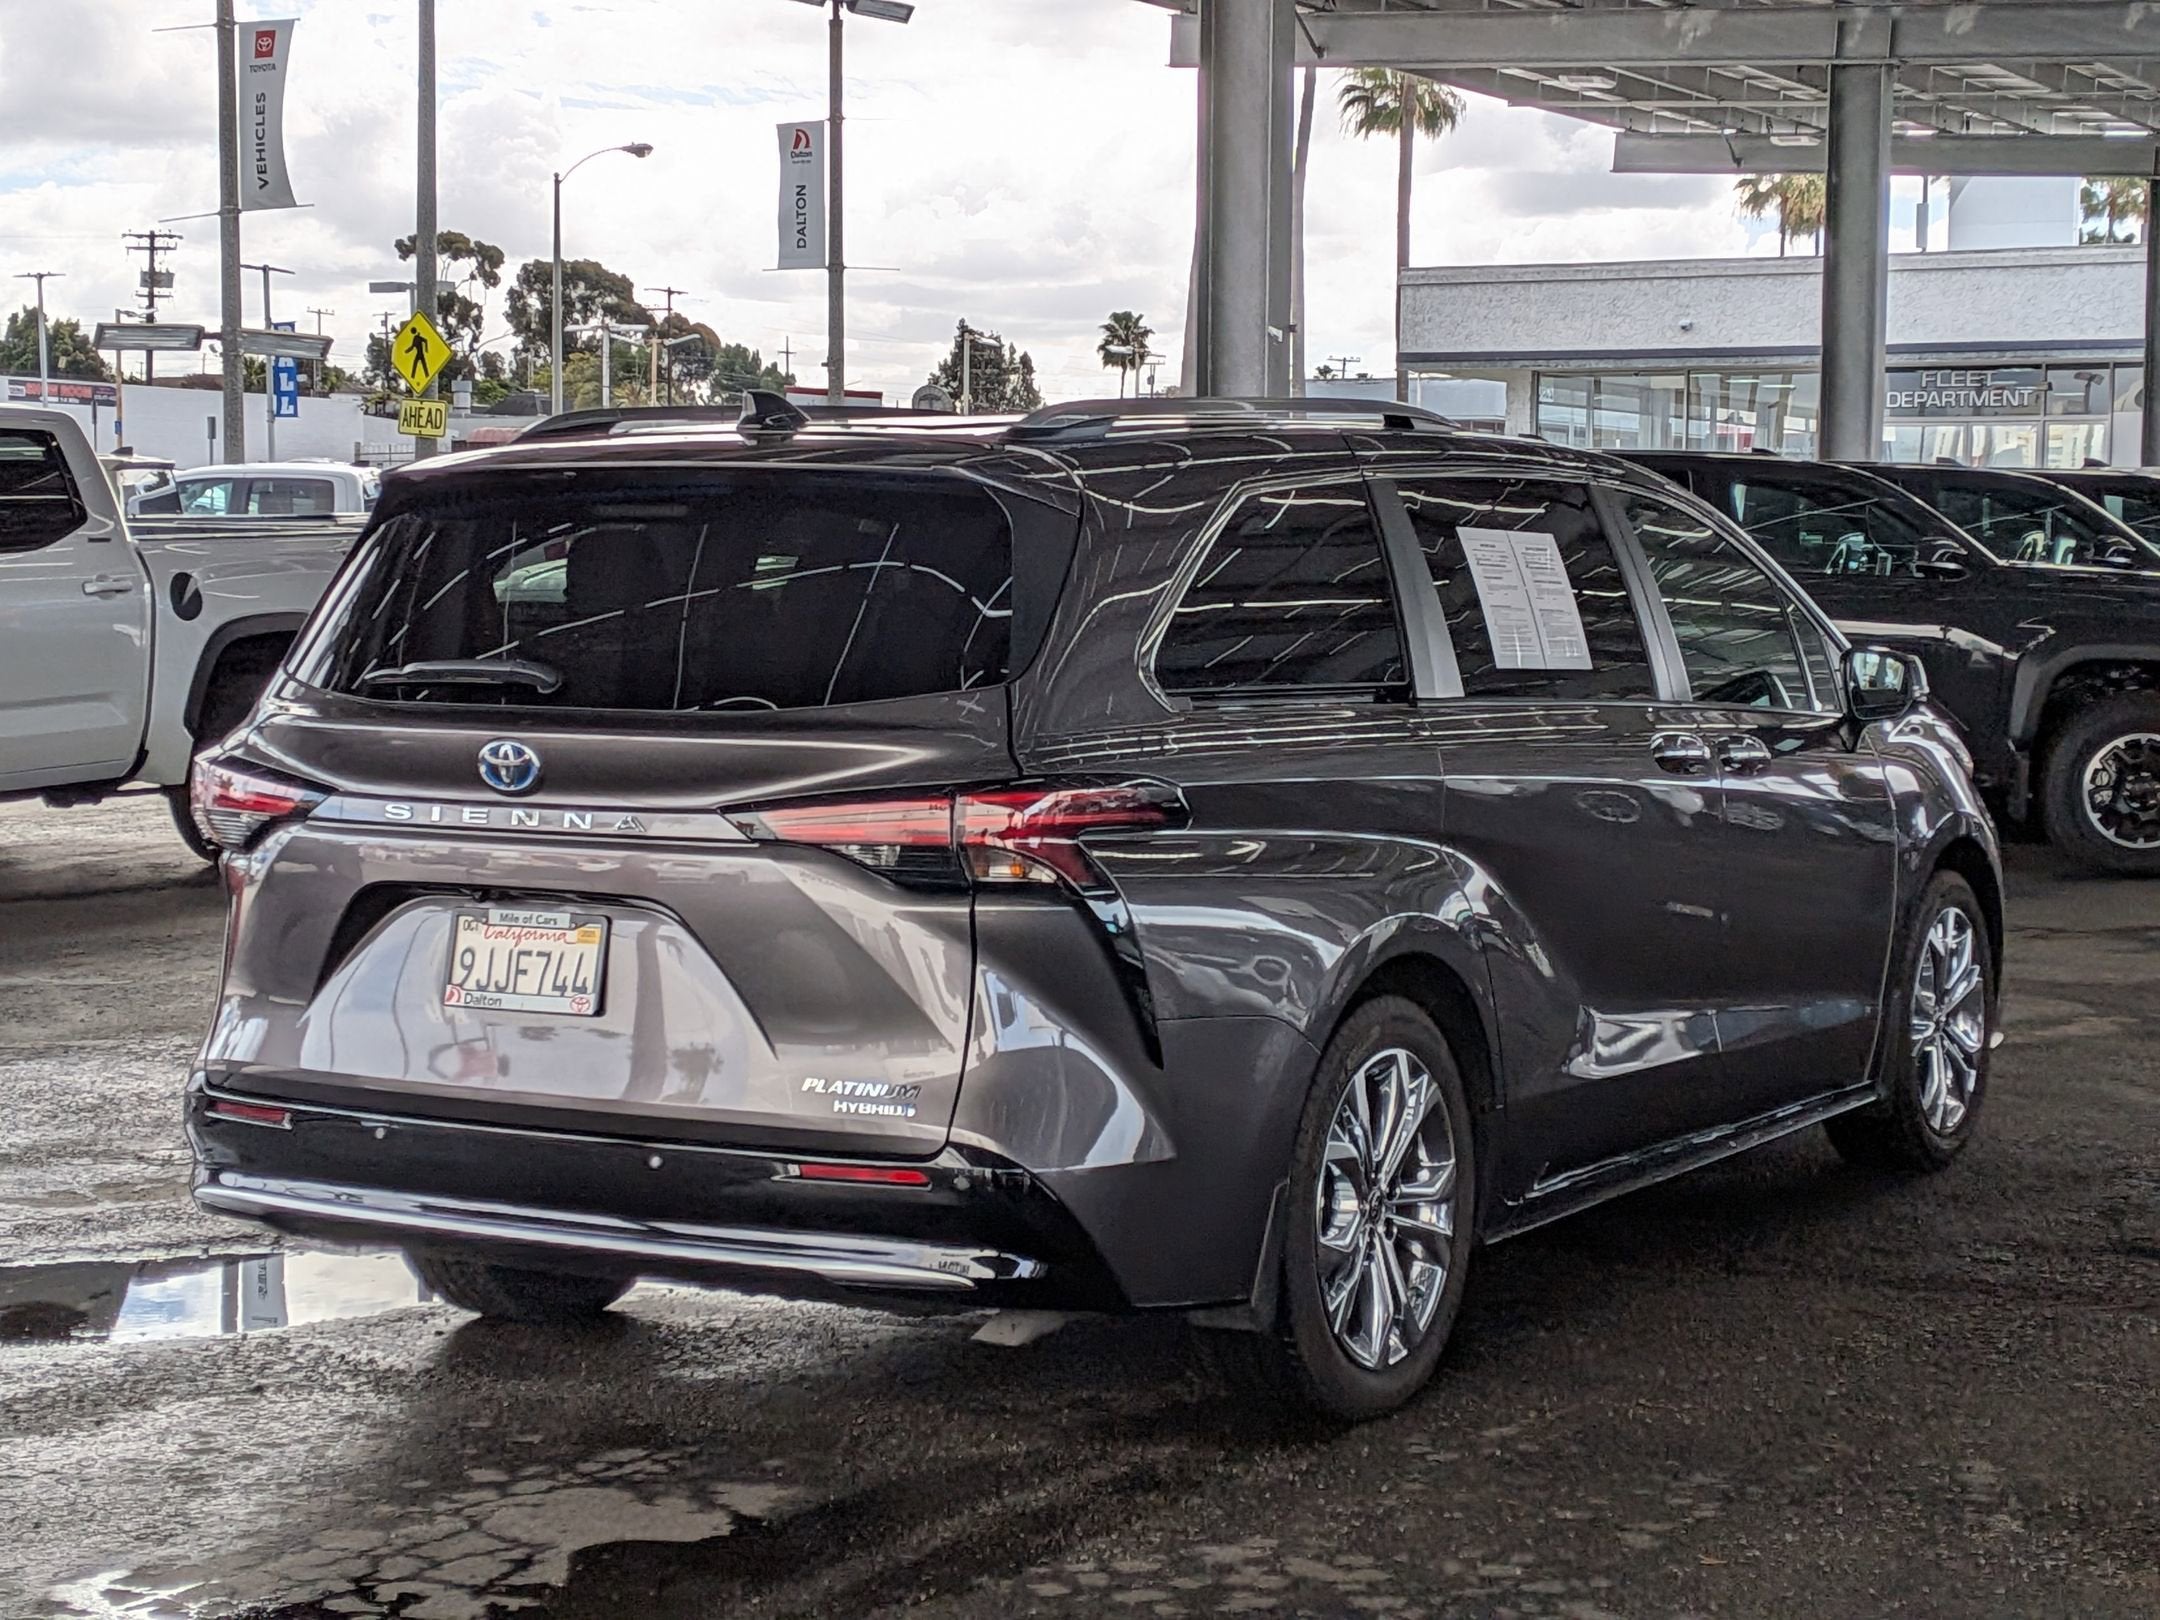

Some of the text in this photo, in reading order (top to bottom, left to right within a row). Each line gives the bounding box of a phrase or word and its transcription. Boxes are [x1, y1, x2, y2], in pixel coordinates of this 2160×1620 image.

[249, 64, 277, 73] TOYOTA
[256, 92, 269, 190] VEHICLES
[795, 184, 807, 249] DALTON
[1921, 370, 1998, 387] FLEET
[1886, 391, 2032, 408] DEPARTMENT
[401, 406, 443, 430] AHEAD
[384, 803, 646, 832] SIENNA
[499, 912, 558, 926] Mile of Cars
[483, 925, 577, 948] California
[460, 946, 588, 997] 9JJF744
[463, 992, 502, 1007] Dalton
[801, 1078, 921, 1099] PLATINUM
